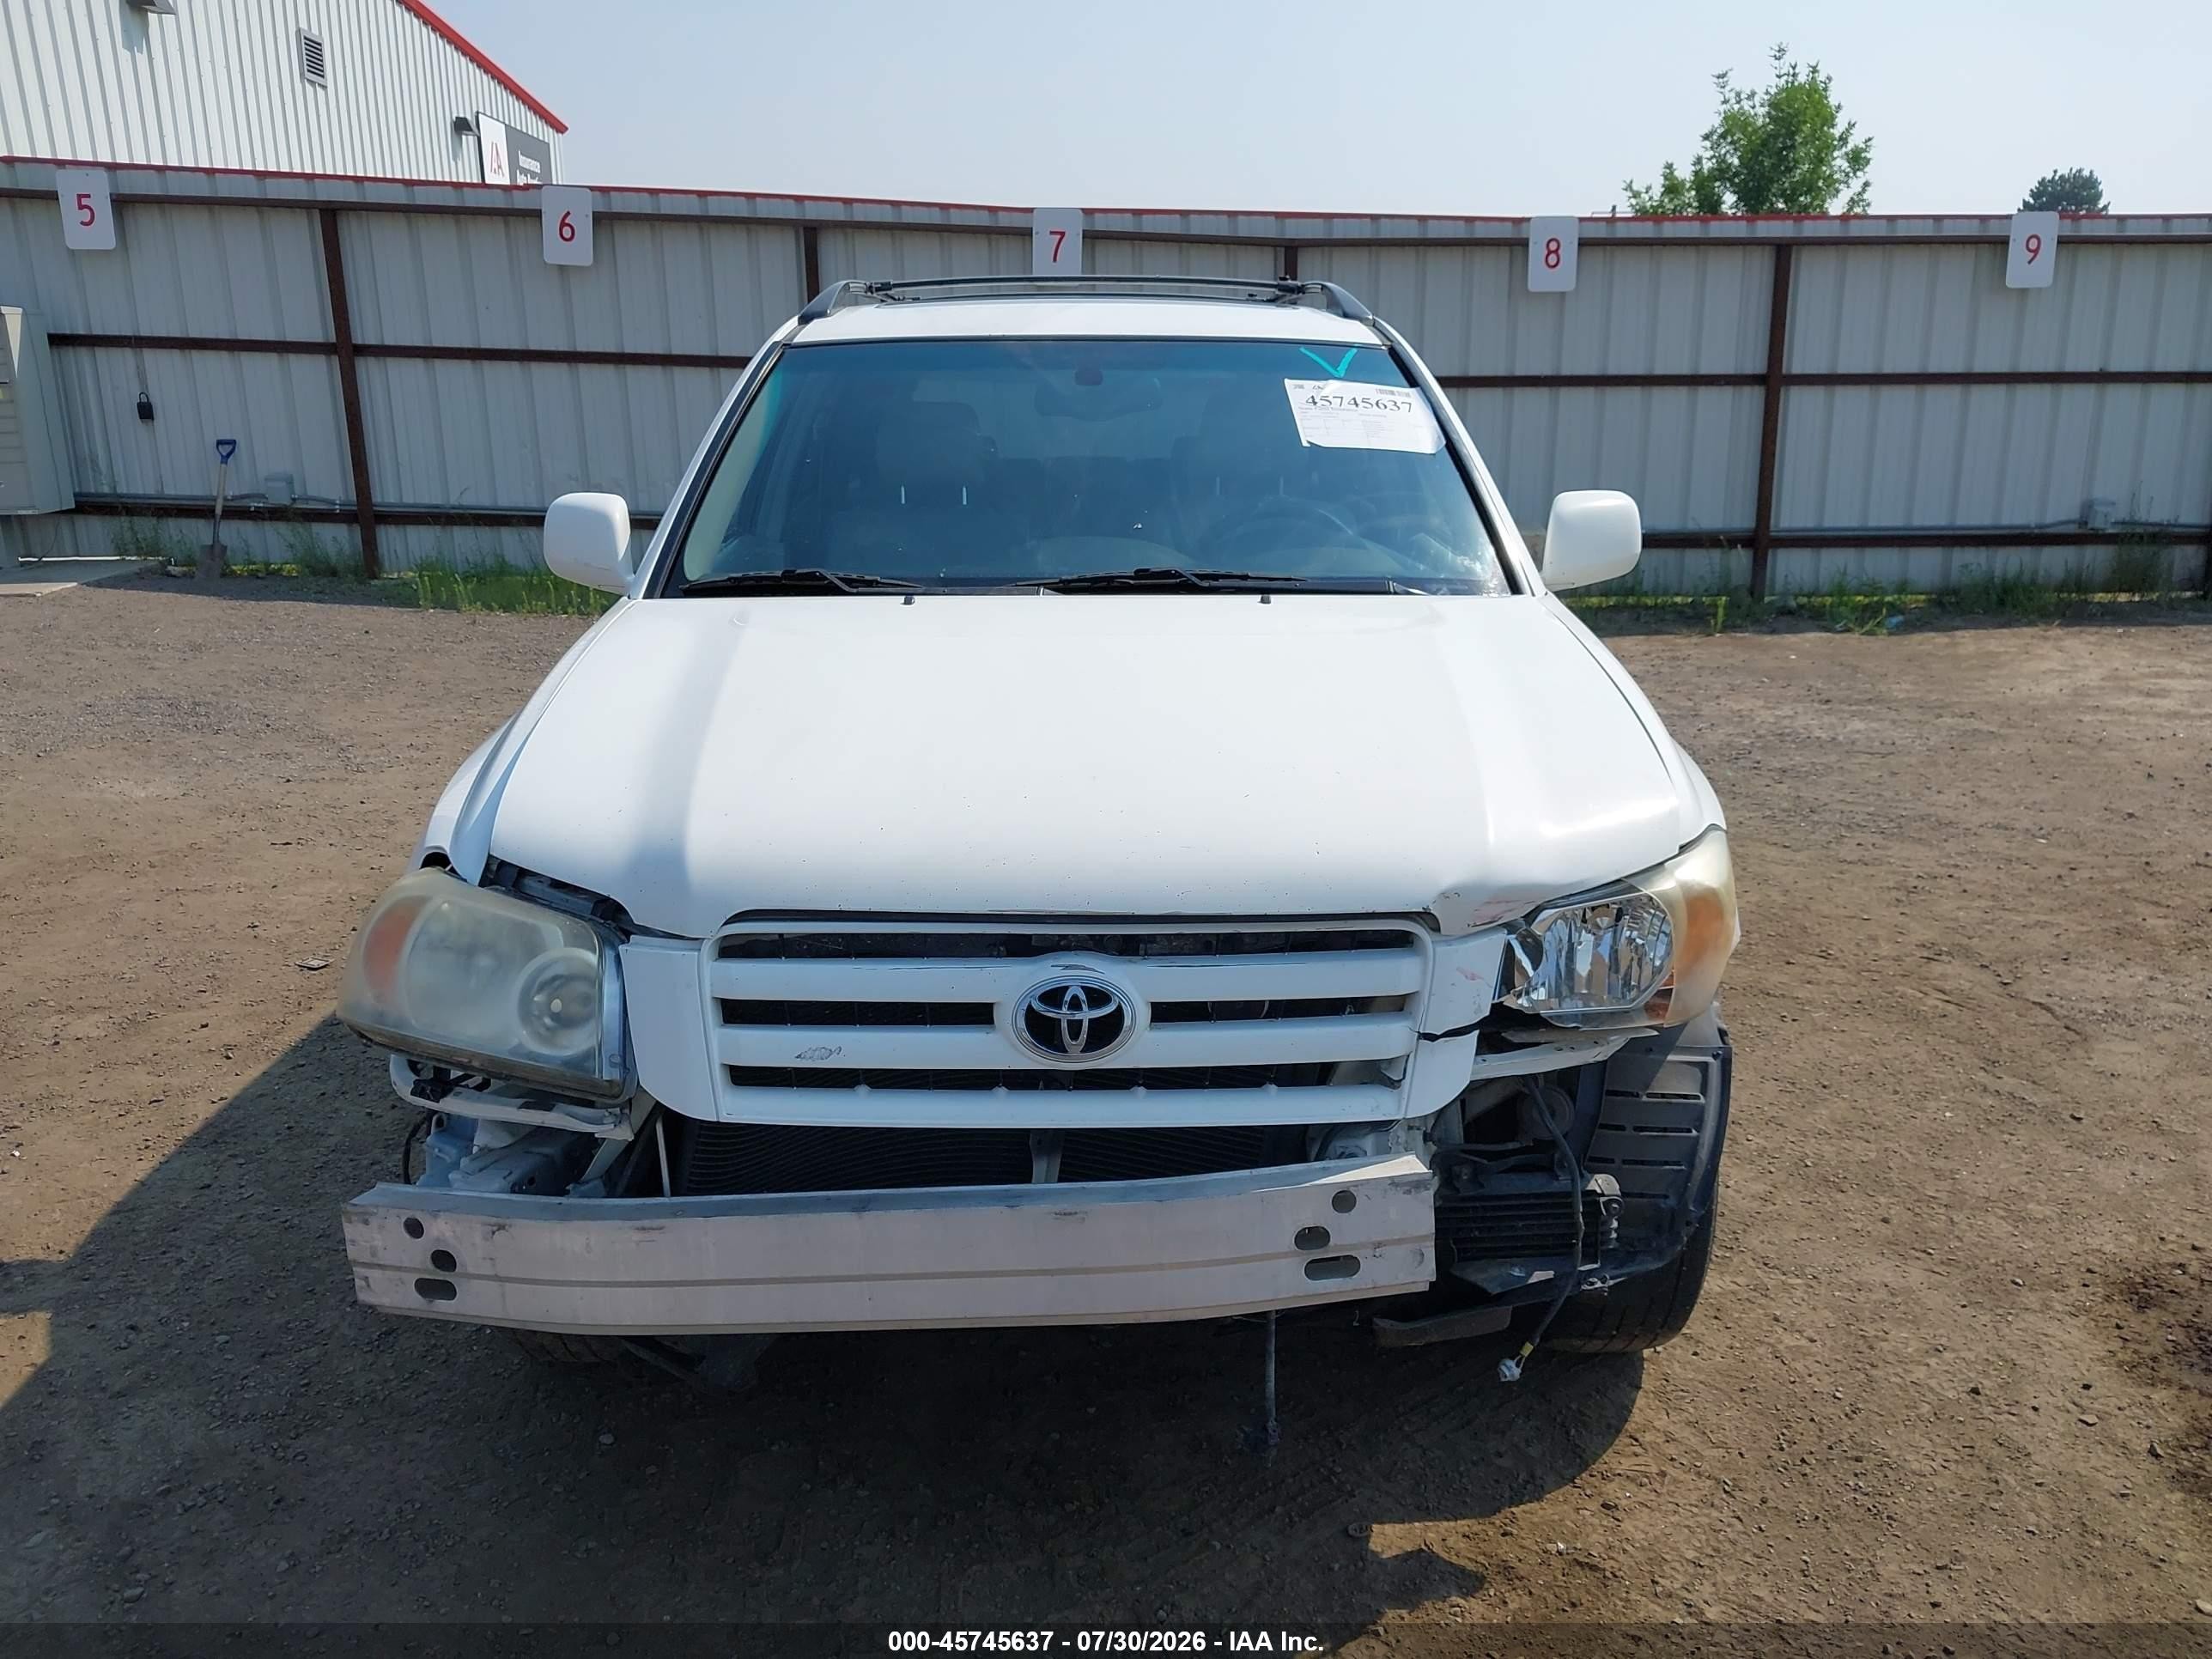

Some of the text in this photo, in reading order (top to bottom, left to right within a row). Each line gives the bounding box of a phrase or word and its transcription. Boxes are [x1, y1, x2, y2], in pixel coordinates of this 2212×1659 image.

[76, 193, 96, 227] 5
[558, 210, 575, 242] 6
[1049, 230, 1066, 264] 7
[1544, 237, 1561, 270] 8
[2025, 233, 2042, 264] 9
[1305, 395, 1413, 413] 45745637
